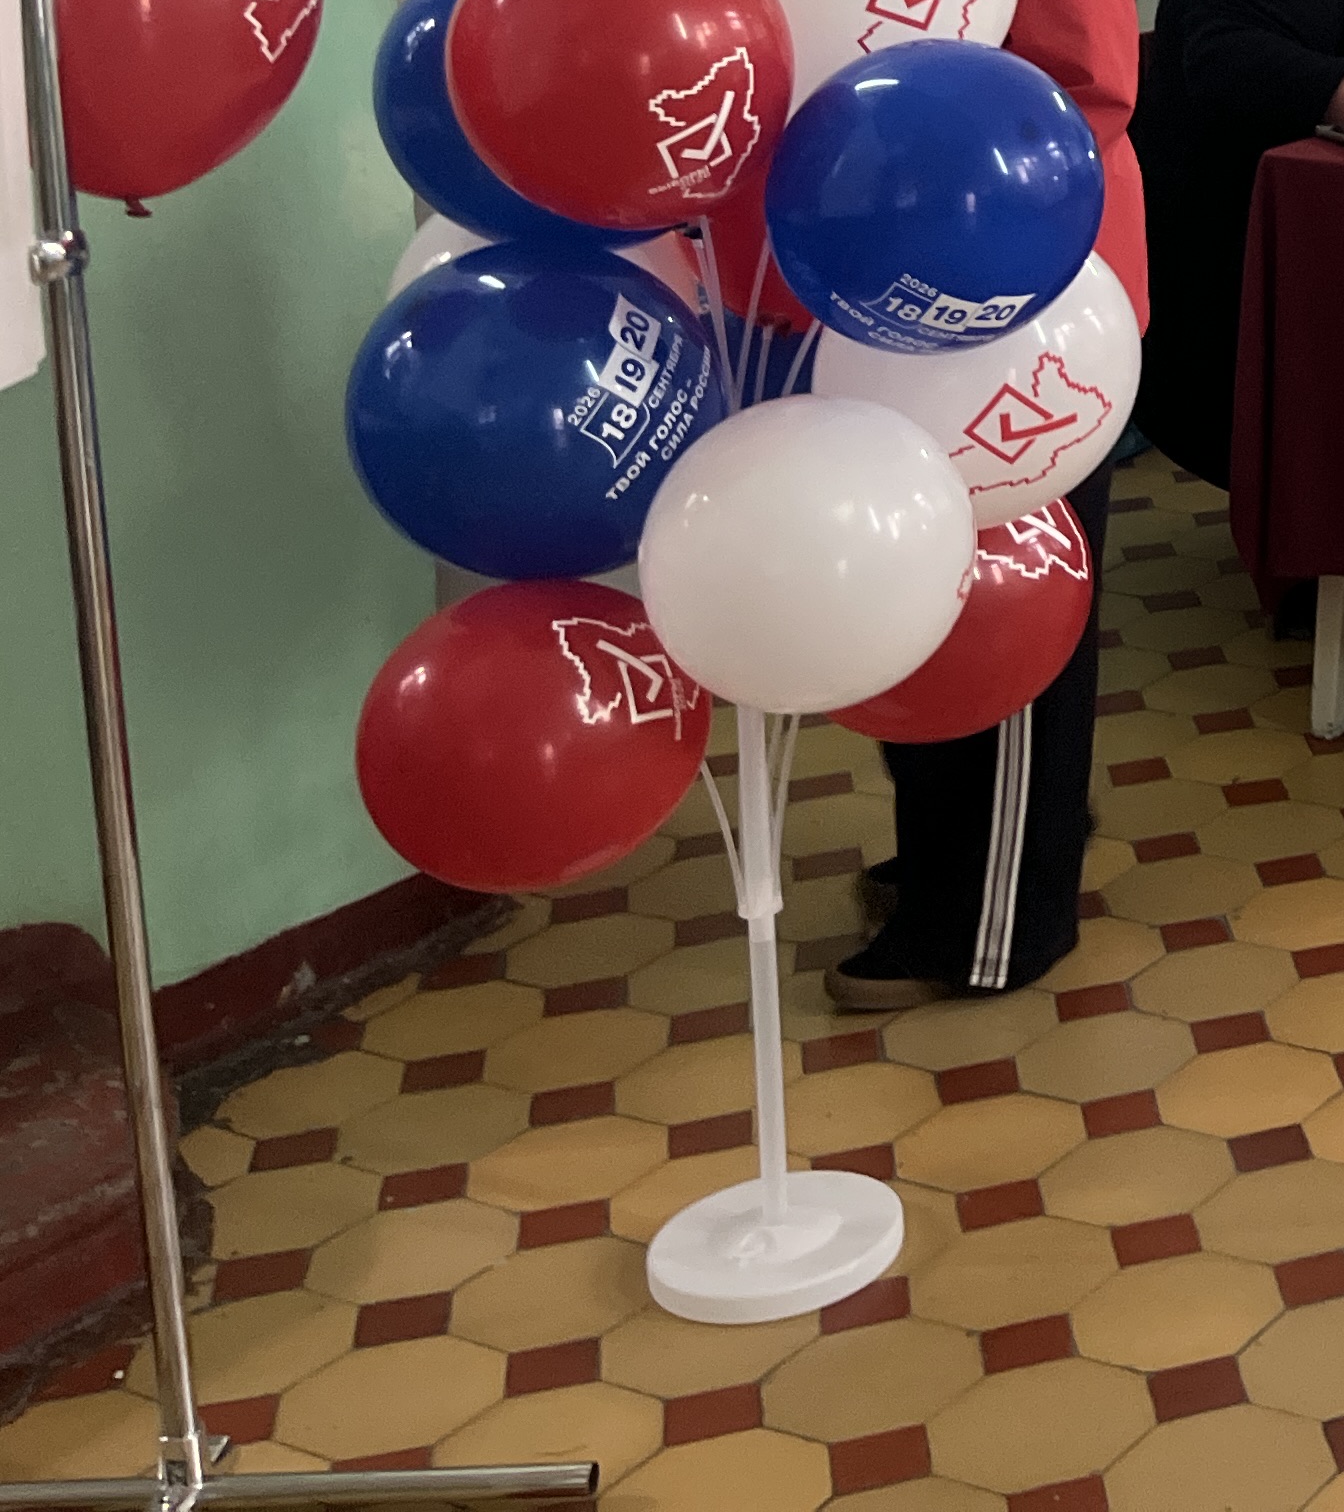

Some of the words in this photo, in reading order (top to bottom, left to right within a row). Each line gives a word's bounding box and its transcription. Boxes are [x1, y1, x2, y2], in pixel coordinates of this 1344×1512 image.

[900, 273, 939, 297] 2026
[829, 290, 876, 326] ТВОЙ
[885, 296, 923, 322] 18
[932, 304, 968, 326] 19
[974, 304, 1017, 321] 20
[619, 310, 650, 352] 20
[614, 357, 646, 393] 19
[648, 333, 684, 410] СЕНТЯБРЯ
[567, 387, 601, 427] 2026
[601, 403, 638, 441] 18
[605, 450, 652, 500] ТВОЙ
[648, 388, 689, 451] ГОЛОС
[660, 412, 695, 462] СИЛА
